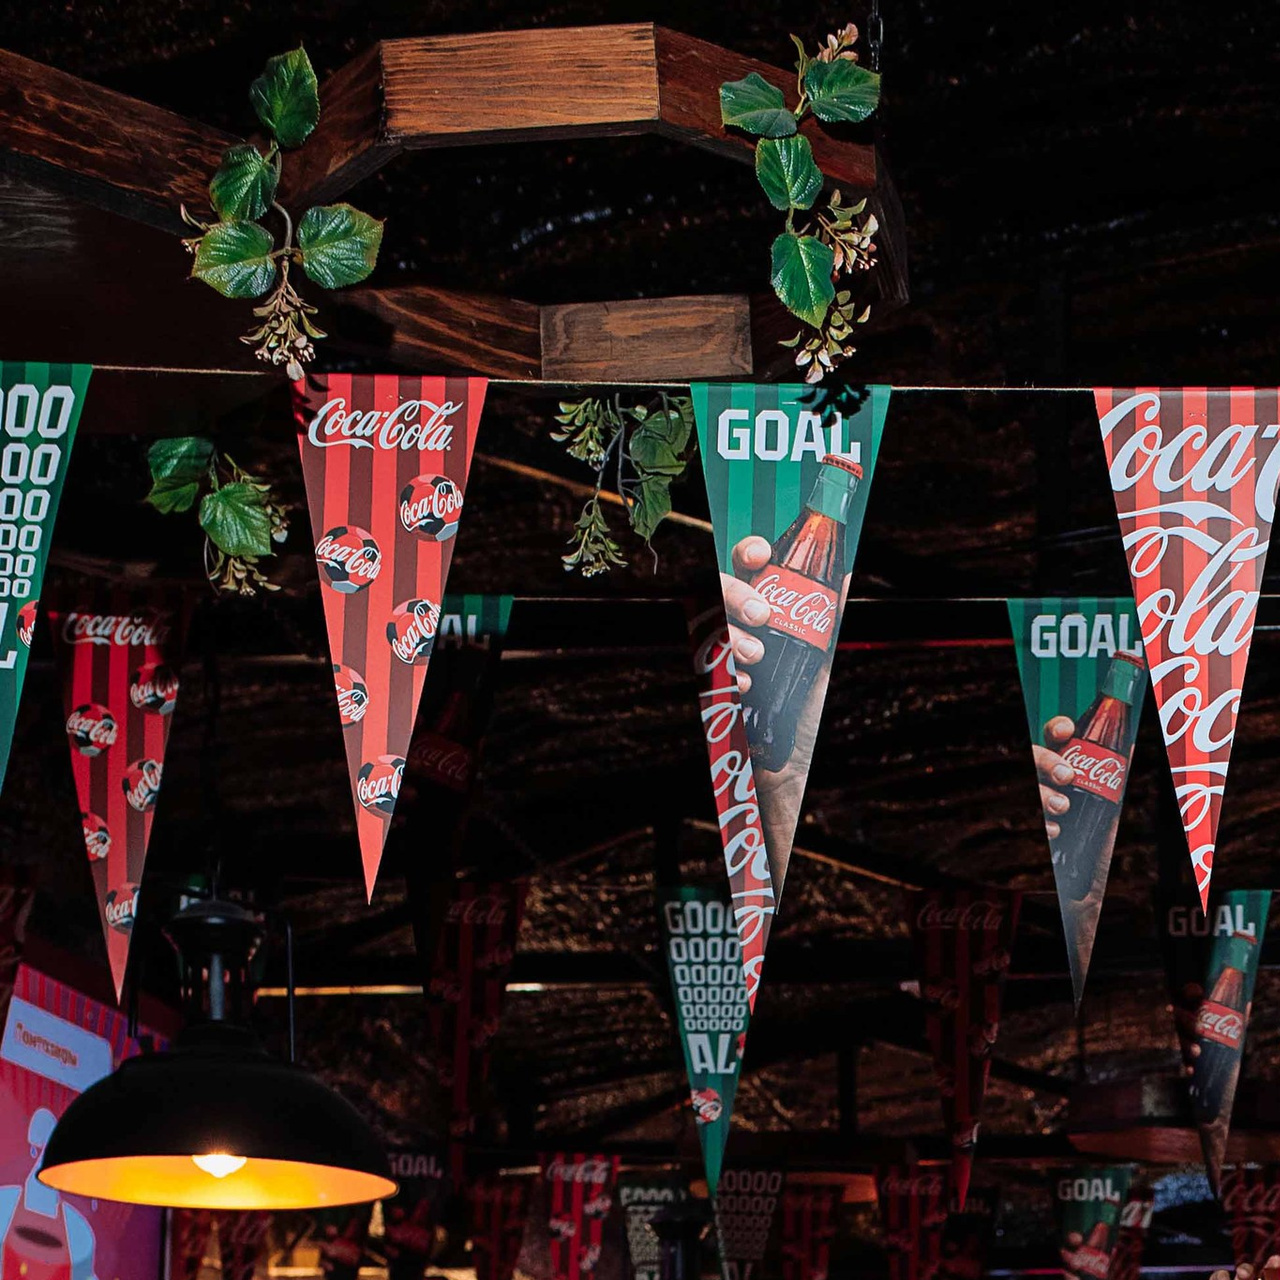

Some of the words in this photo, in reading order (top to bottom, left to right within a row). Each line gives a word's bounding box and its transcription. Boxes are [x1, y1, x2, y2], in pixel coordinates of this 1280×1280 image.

[0, 384, 75, 438] OO
[308, 399, 464, 452] Coca-Cola
[717, 408, 861, 461] GOAL
[438, 612, 491, 649] AL
[774, 618, 806, 634] CLASSIC
[1031, 613, 1141, 659] GOAL
[1168, 904, 1256, 939] GOAL
[687, 1034, 738, 1074] AL
[1058, 1178, 1120, 1202] GOAL
